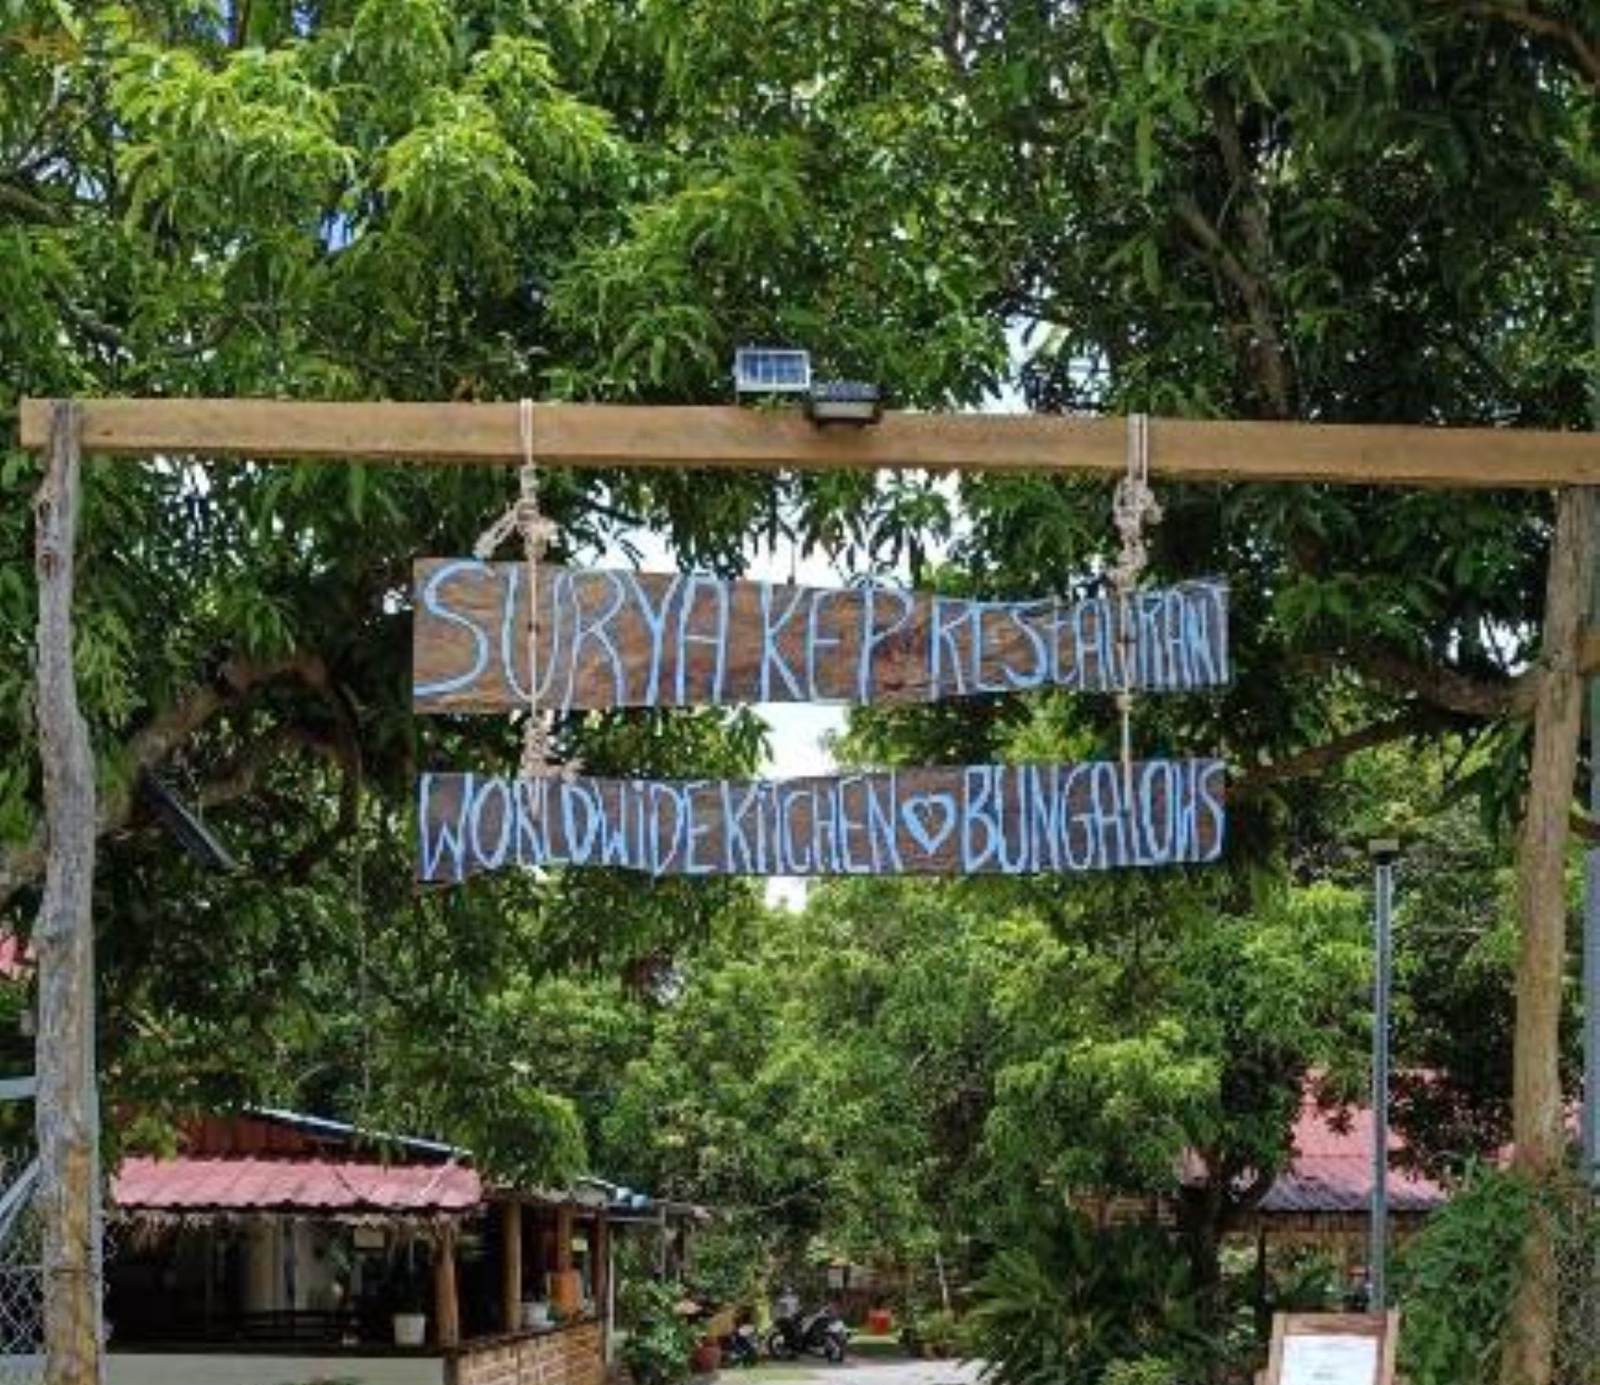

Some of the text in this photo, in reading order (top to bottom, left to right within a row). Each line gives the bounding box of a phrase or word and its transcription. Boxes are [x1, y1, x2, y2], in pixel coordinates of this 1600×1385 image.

[413, 561, 726, 720] SURYA
[760, 577, 914, 704] KEP
[961, 758, 1227, 873] BUNGALOWS
